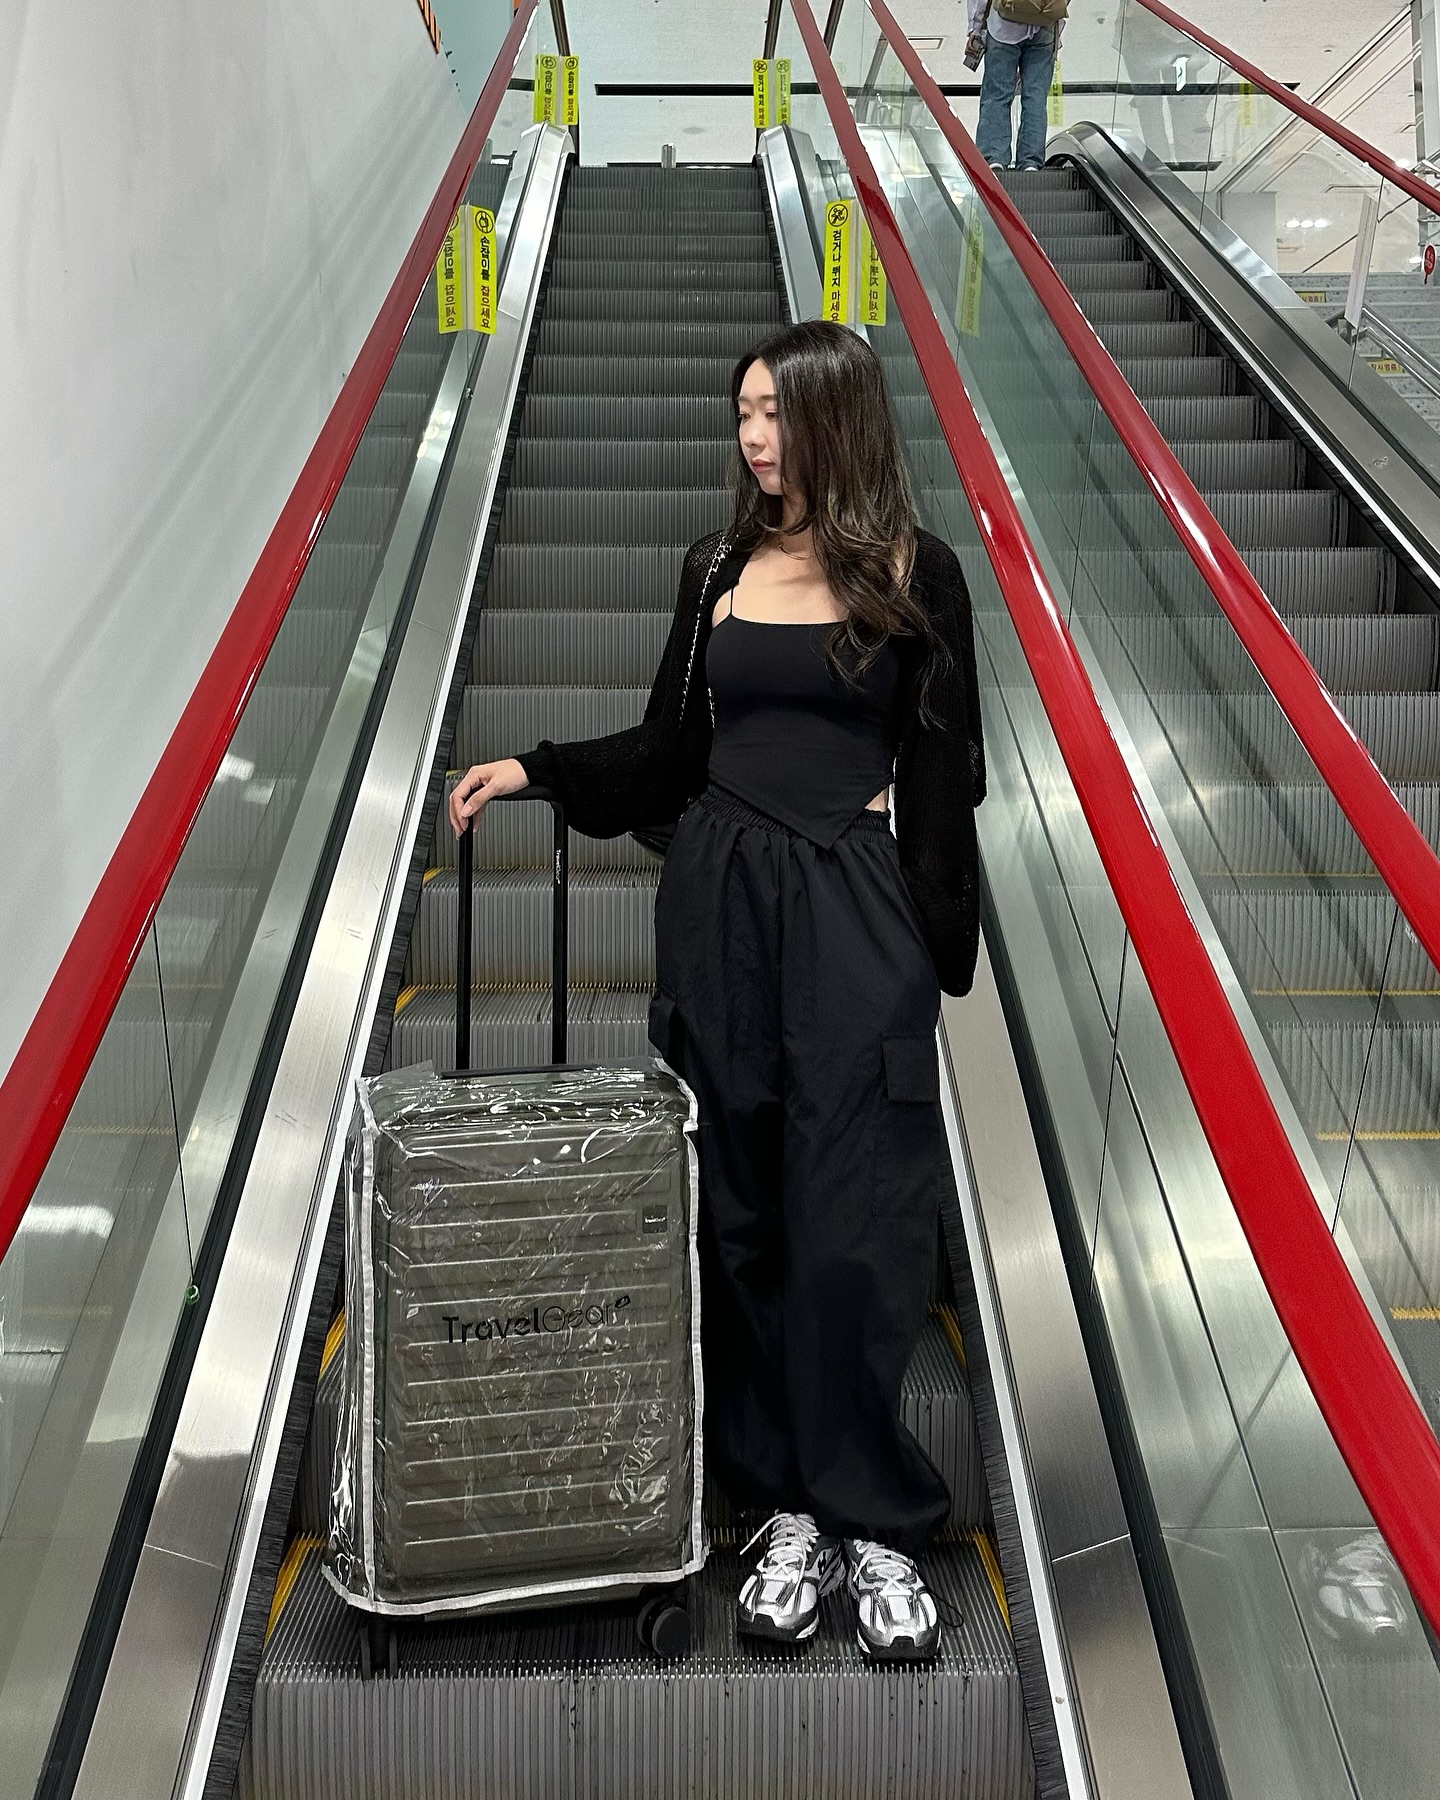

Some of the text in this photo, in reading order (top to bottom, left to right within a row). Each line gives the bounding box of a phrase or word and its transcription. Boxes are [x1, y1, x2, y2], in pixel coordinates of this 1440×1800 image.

[480, 236, 491, 329] 손잡이를 잡으세요
[830, 230, 842, 321] 걷거나 뛰지 마세요
[442, 1302, 616, 1344] TravelGear
